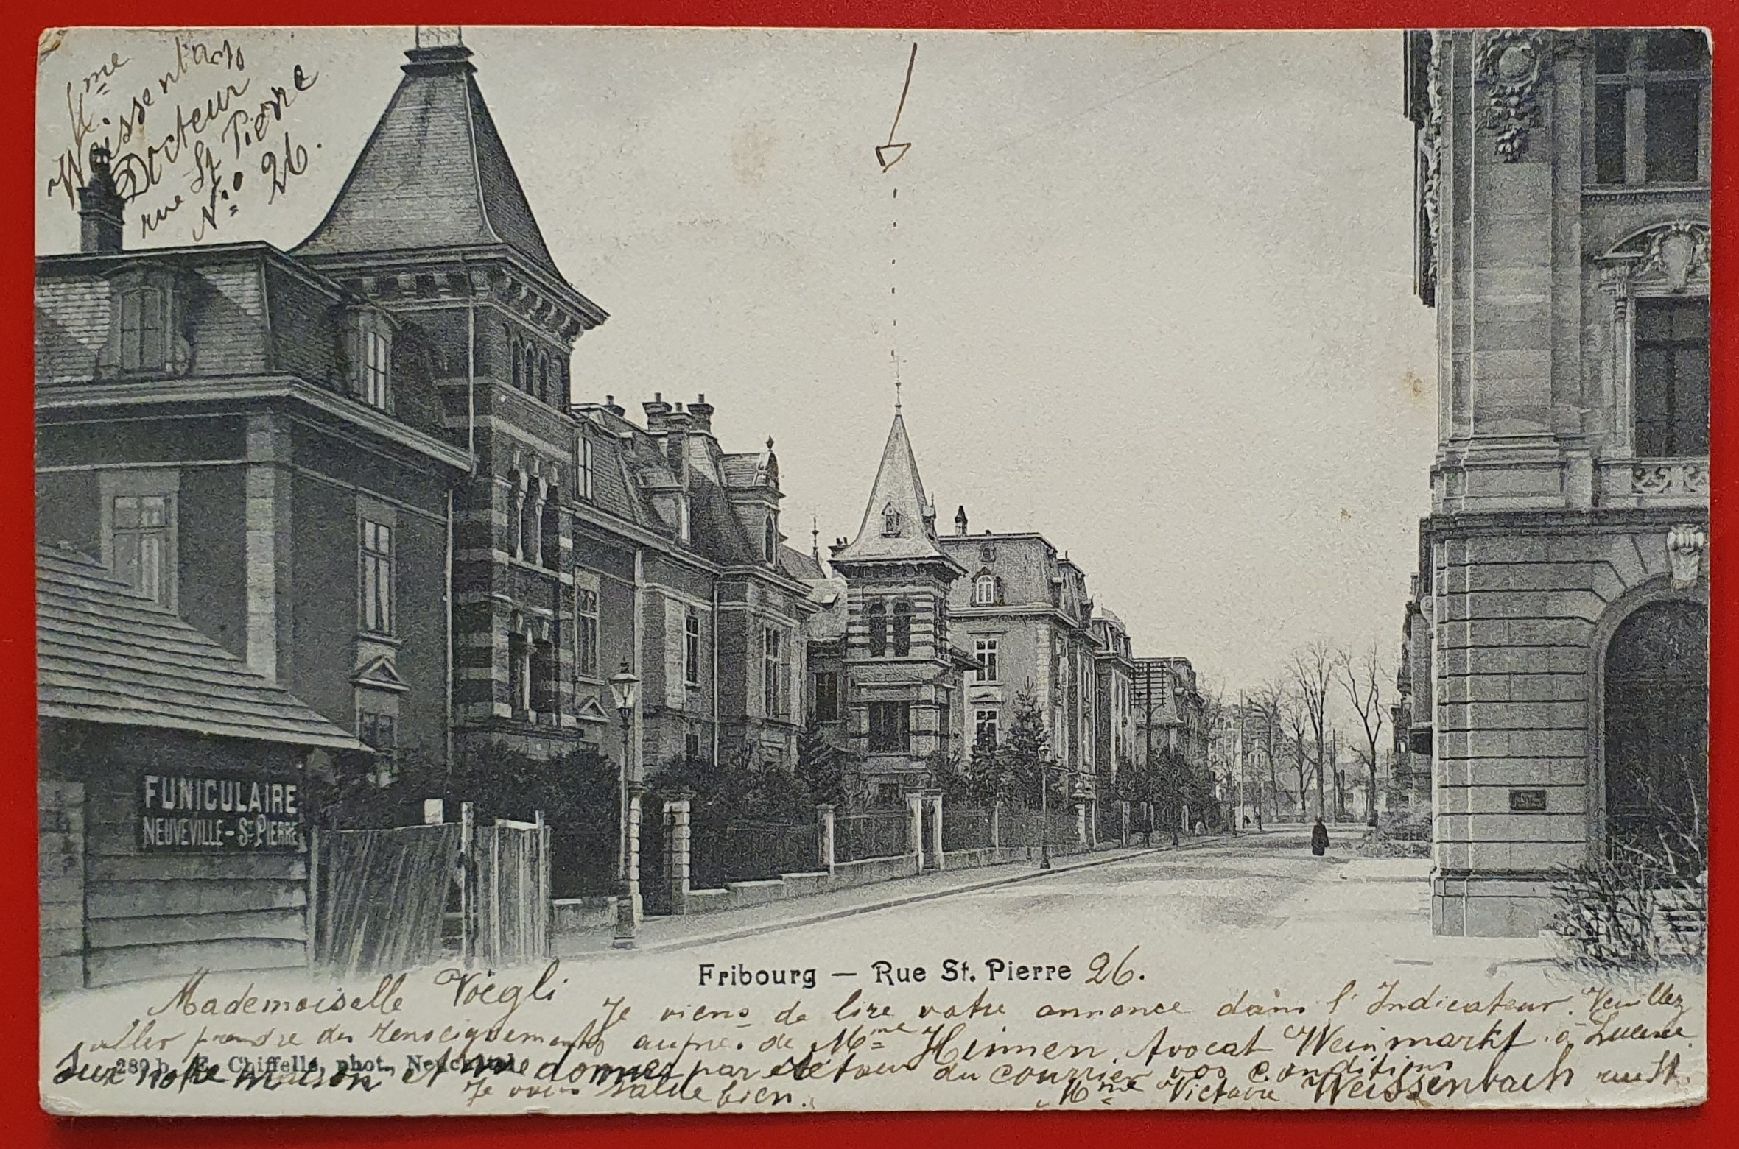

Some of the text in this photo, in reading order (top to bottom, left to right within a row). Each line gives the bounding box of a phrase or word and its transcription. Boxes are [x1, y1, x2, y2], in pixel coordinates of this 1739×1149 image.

[112, 77, 251, 203] Docteur
[141, 194, 185, 240] rue
[143, 774, 298, 814] FUNICULAIRE
[147, 966, 404, 1017] Mademoiselle
[699, 964, 817, 990] Fribourg
[871, 961, 927, 987] Rue
[940, 958, 976, 982] St.
[986, 958, 1073, 982] Pierre
[602, 996, 632, 1032] Je
[660, 1002, 752, 1029] viens
[774, 1000, 808, 1026] de
[834, 988, 895, 1021] lire
[918, 986, 1007, 1019] votre
[1035, 1001, 1192, 1019] annonce
[1217, 989, 1306, 1018] dans
[1581, 981, 1692, 1032] Veuillez
[90, 1018, 186, 1051] aller
[182, 1025, 304, 1064] prendre
[316, 1023, 353, 1045] des
[758, 1032, 795, 1052] de
[932, 1063, 981, 1082] du
[1169, 1063, 1227, 1081] vos
[1301, 1043, 1575, 1106] Weissenbach
